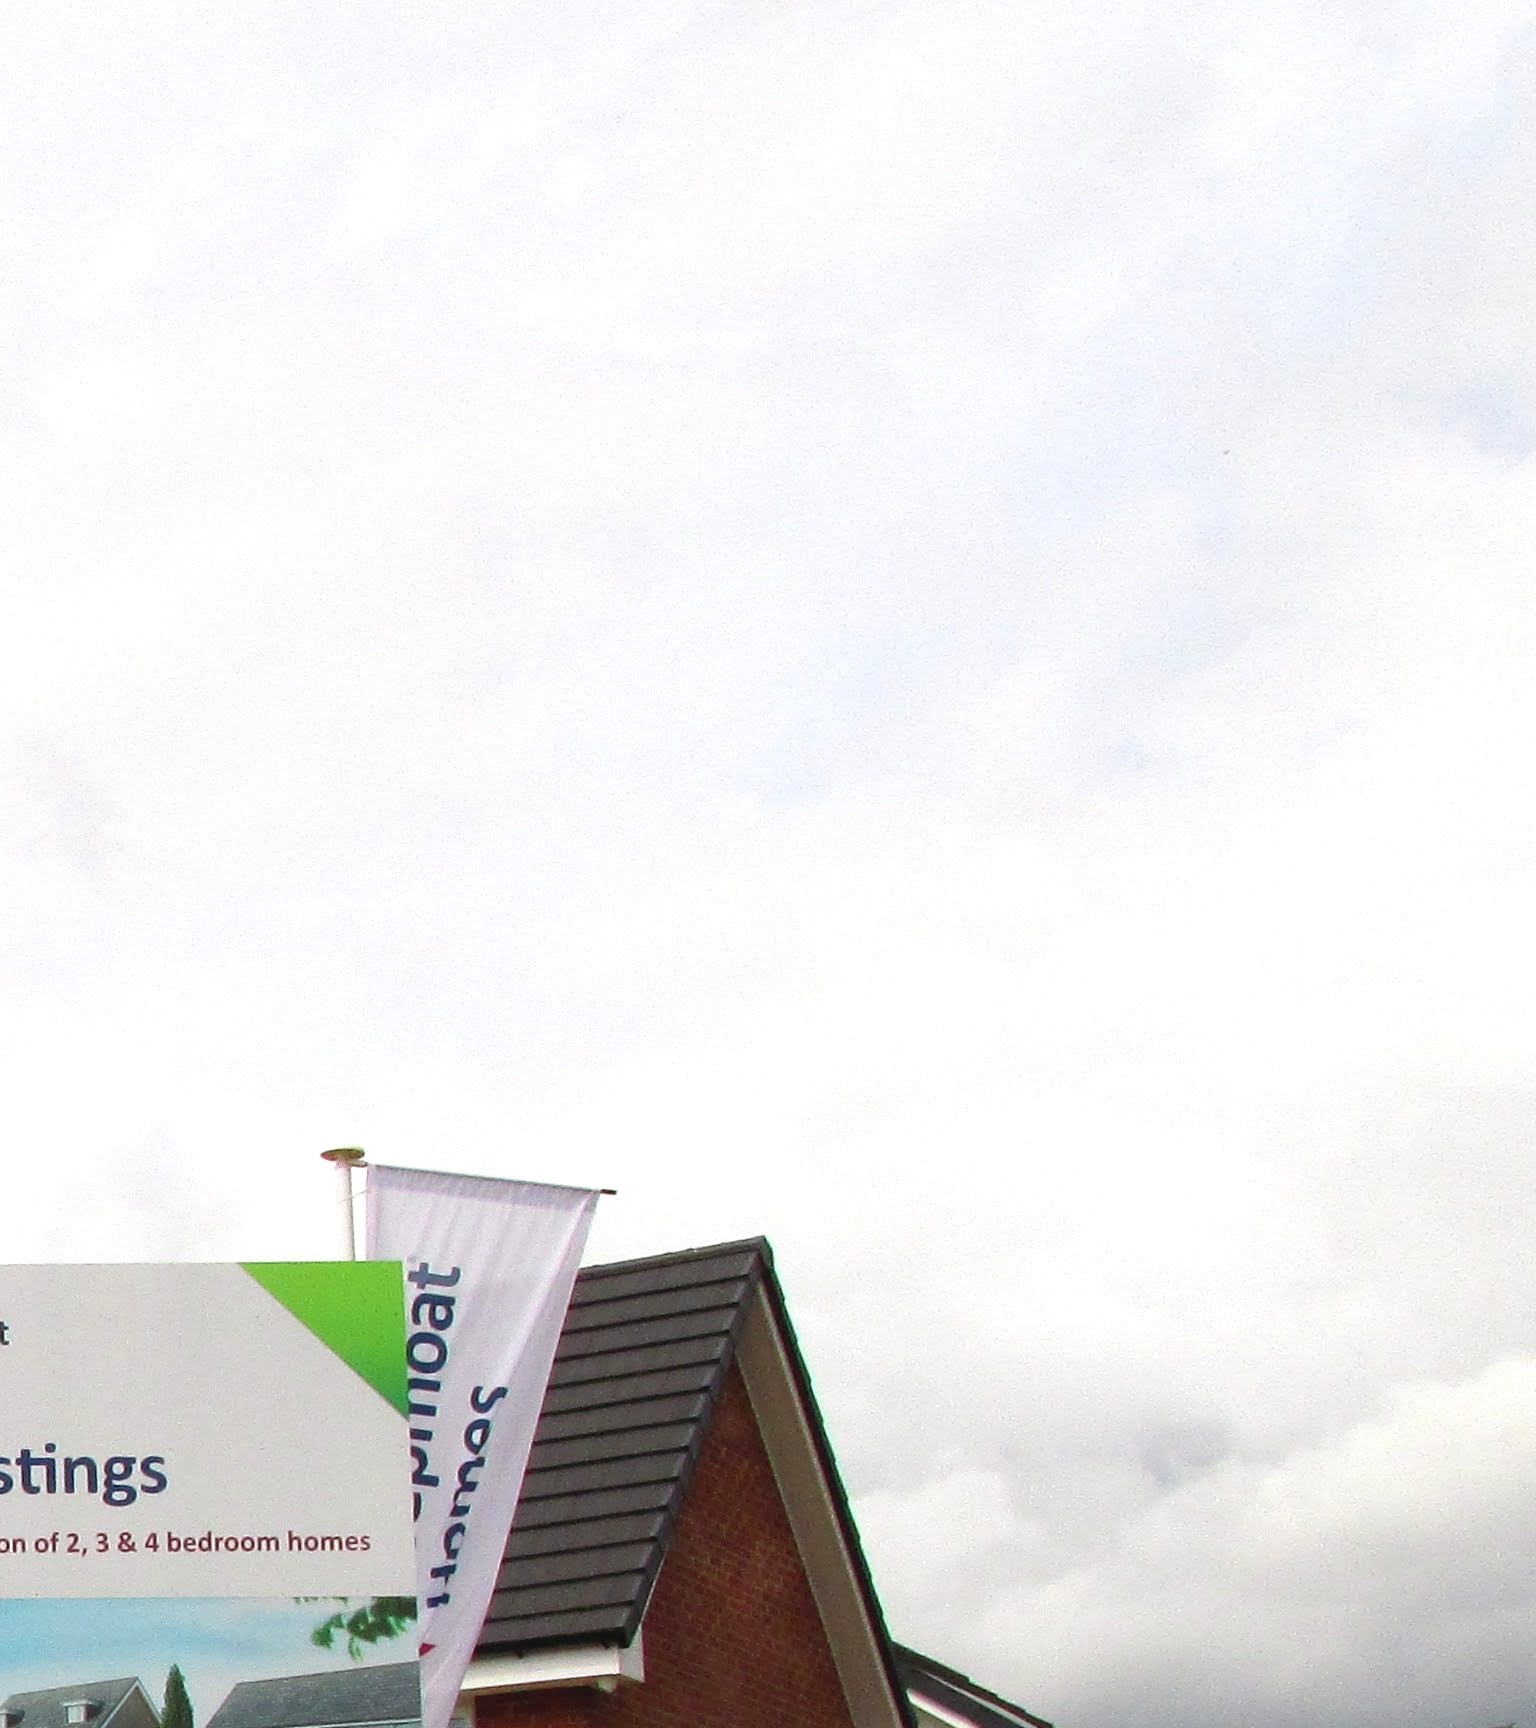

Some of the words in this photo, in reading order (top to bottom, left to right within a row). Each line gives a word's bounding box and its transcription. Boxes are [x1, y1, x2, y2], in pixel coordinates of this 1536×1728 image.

[406, 1262, 461, 1522] pmoat
[34, 1532, 59, 1554] of
[66, 1534, 88, 1558] 2,
[96, 1533, 109, 1553] 3
[117, 1533, 137, 1553] &
[144, 1533, 159, 1553] 4
[167, 1531, 280, 1552] bedroom
[288, 1531, 371, 1552] homes
